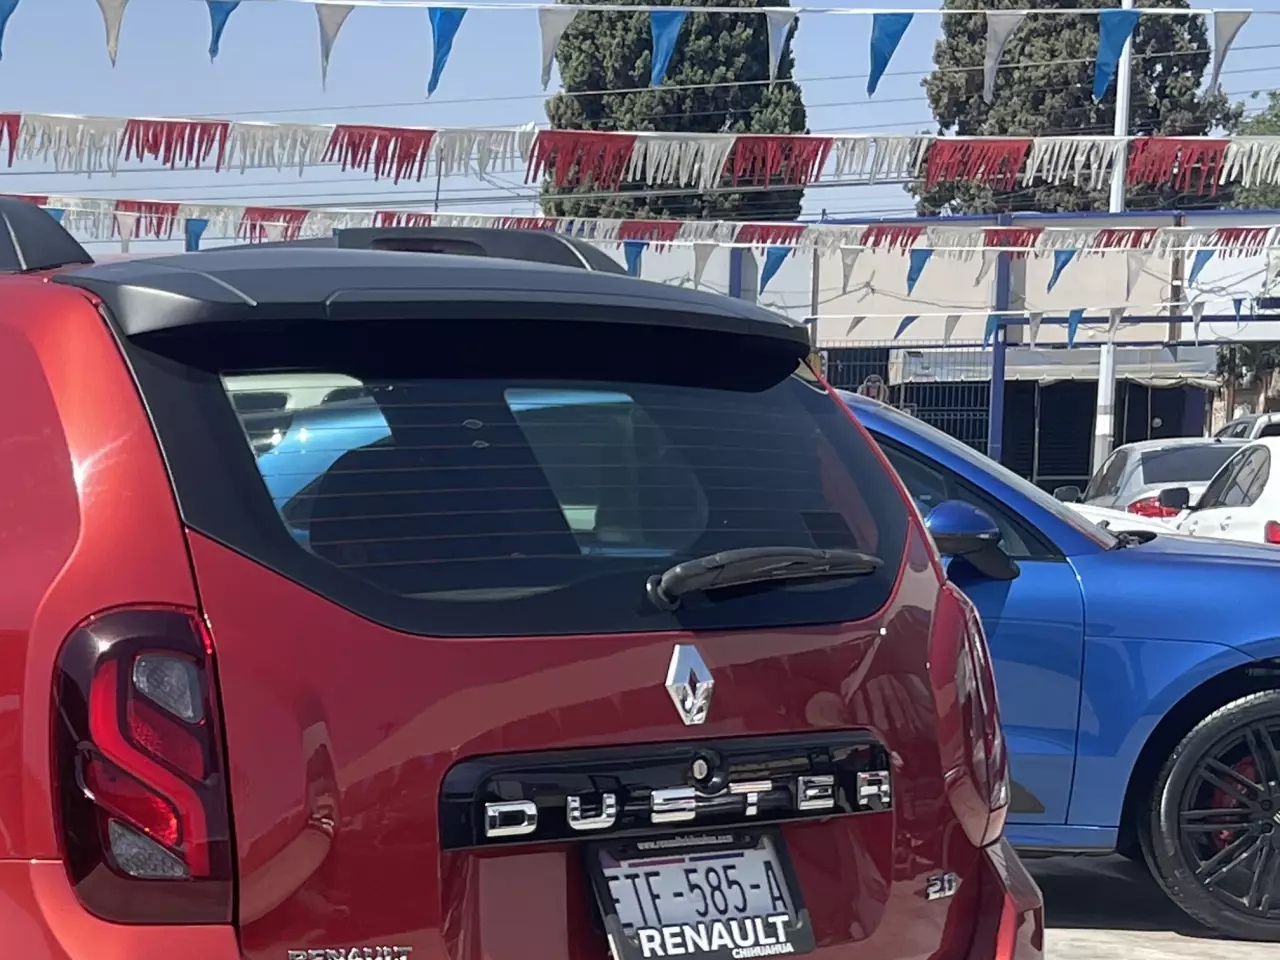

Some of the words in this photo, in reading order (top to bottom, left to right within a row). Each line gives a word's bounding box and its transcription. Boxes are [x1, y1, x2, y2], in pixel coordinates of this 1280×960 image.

[484, 770, 891, 838] DUSTER
[637, 914, 790, 958] RENAULT
[732, 942, 795, 960] CHIHUAHUA
